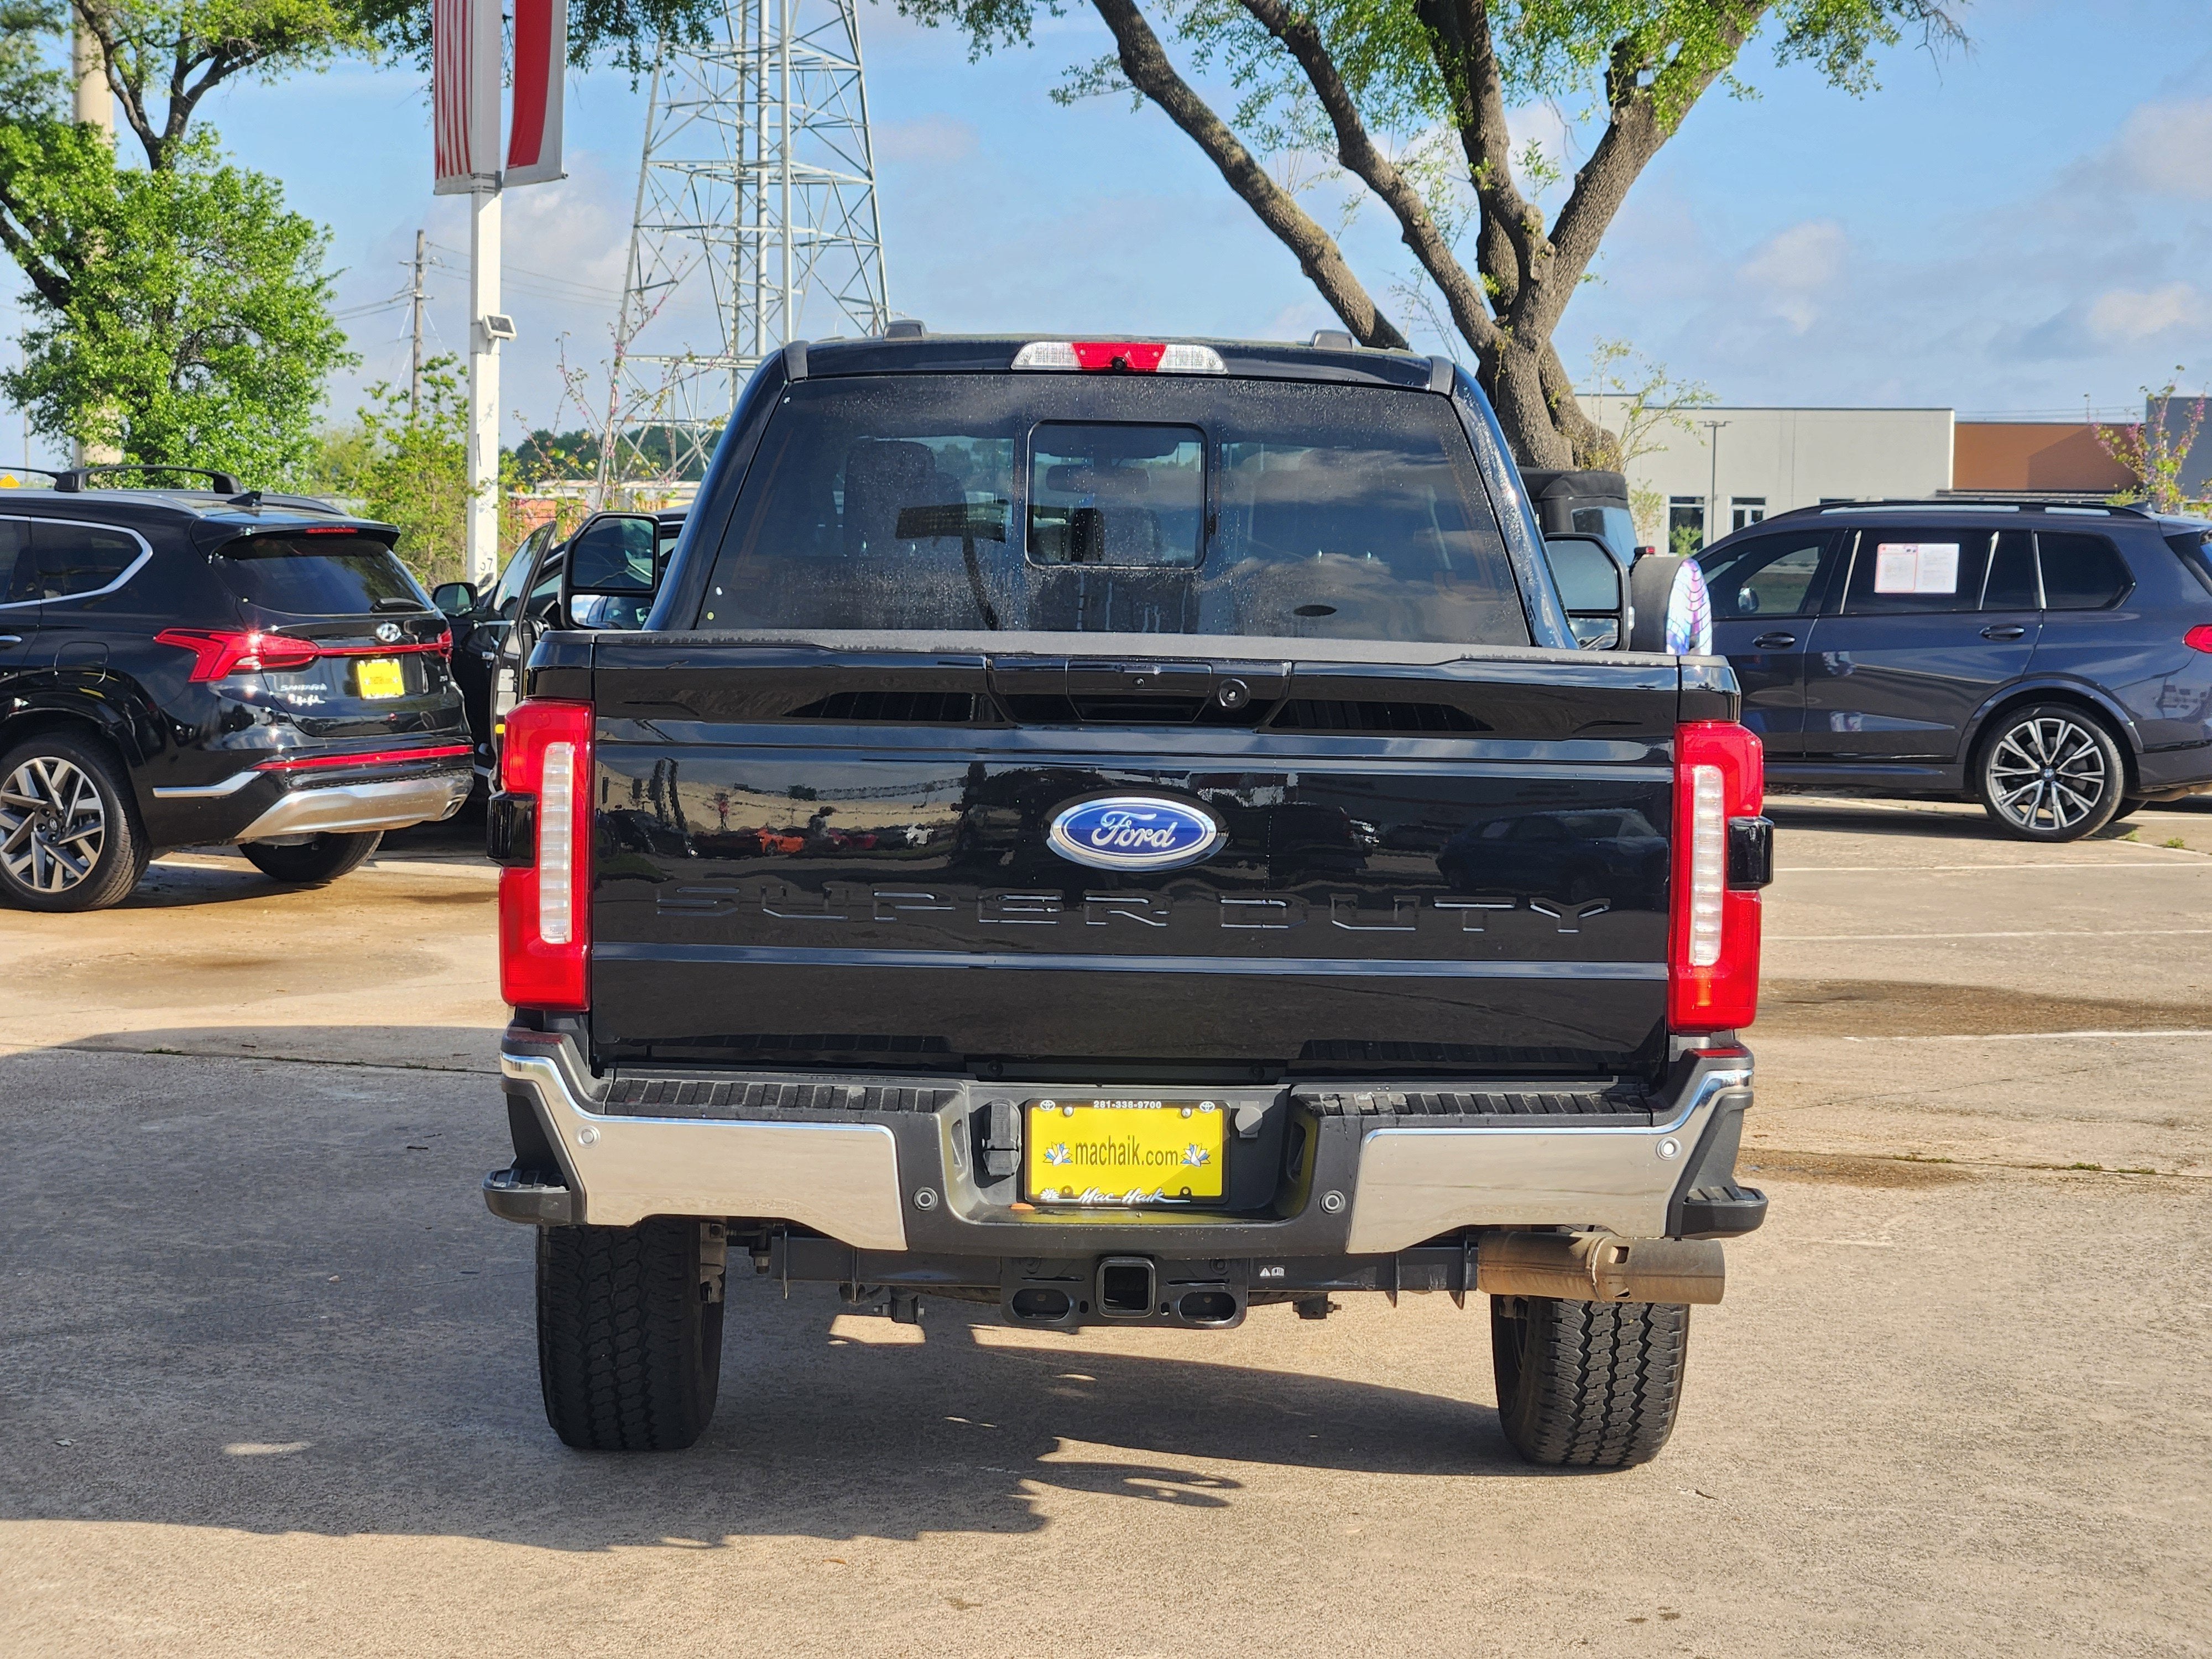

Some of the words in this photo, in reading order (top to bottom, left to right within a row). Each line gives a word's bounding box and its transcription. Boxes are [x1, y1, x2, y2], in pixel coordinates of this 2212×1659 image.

[1091, 811, 1178, 847] Ford
[656, 884, 1173, 927] SUPER
[1219, 891, 1611, 933] DUTY
[1093, 1099, 1162, 1109] 281-338-9700
[1075, 1135, 1178, 1166] machaik.com
[1078, 1187, 1119, 1203] Mac
[1121, 1187, 1170, 1204] Haik
